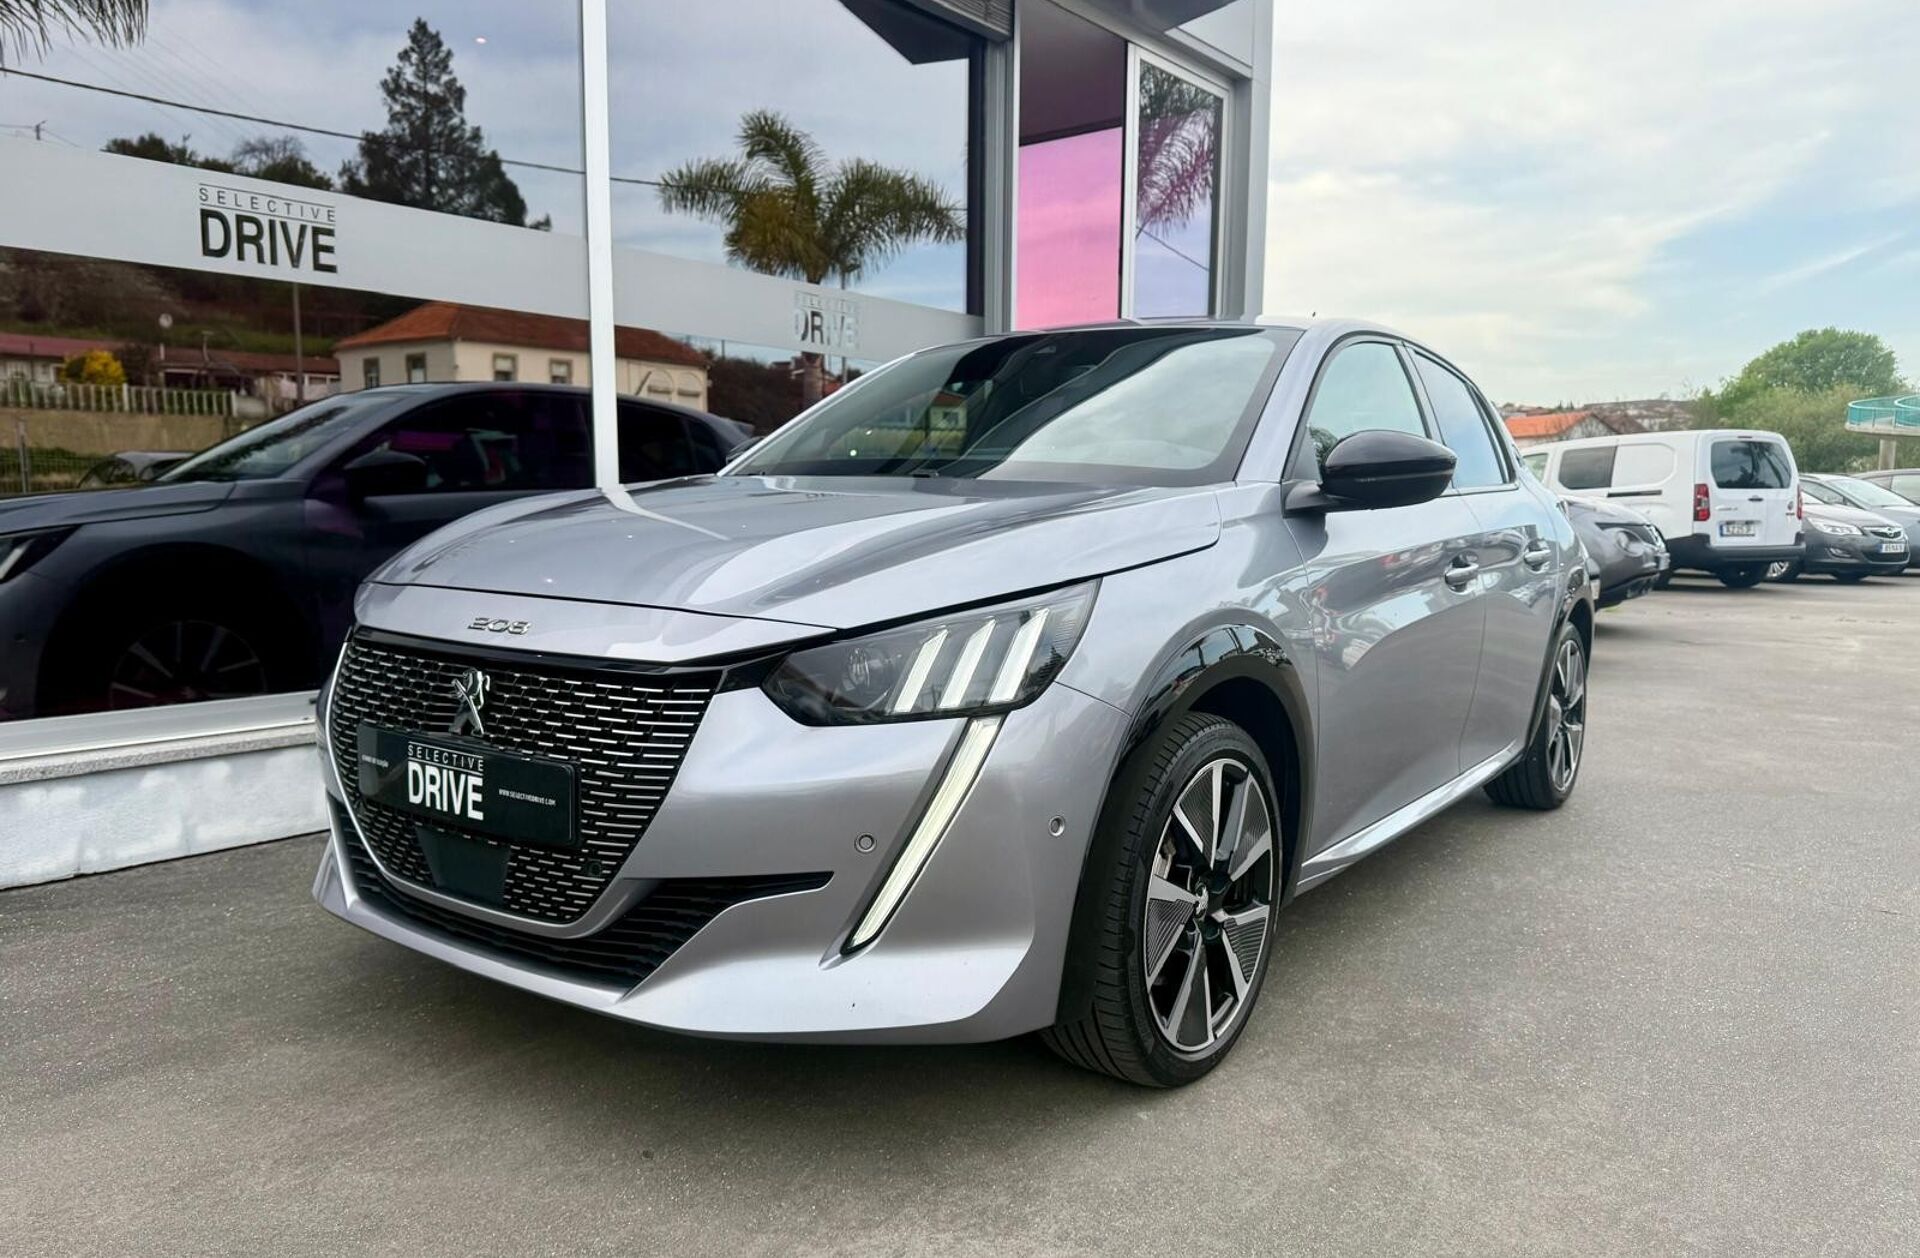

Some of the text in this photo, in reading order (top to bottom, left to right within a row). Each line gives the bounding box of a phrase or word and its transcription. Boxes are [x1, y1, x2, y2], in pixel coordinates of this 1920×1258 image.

[199, 188, 335, 222] SELECTIVE
[200, 208, 338, 273] DRIVE
[467, 617, 531, 635] 208
[408, 744, 484, 772] SELECTIVE
[408, 760, 484, 821] DRIVE
